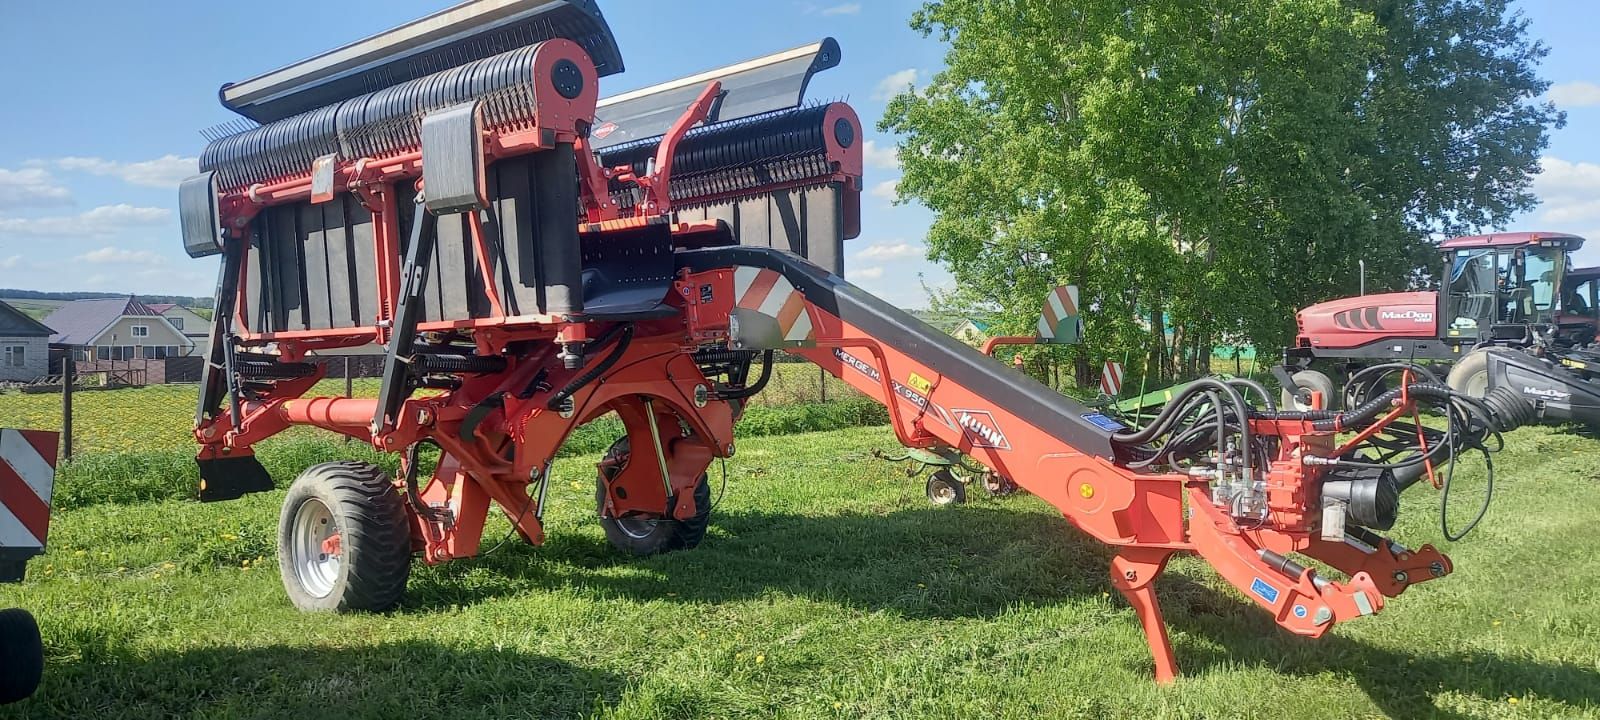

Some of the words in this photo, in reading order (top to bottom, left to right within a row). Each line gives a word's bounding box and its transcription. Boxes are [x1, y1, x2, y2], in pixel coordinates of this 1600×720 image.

[1382, 310, 1433, 319] MacDon
[835, 348, 869, 375] MERGE
[905, 389, 926, 407] 950
[959, 411, 1003, 446] KUHN
